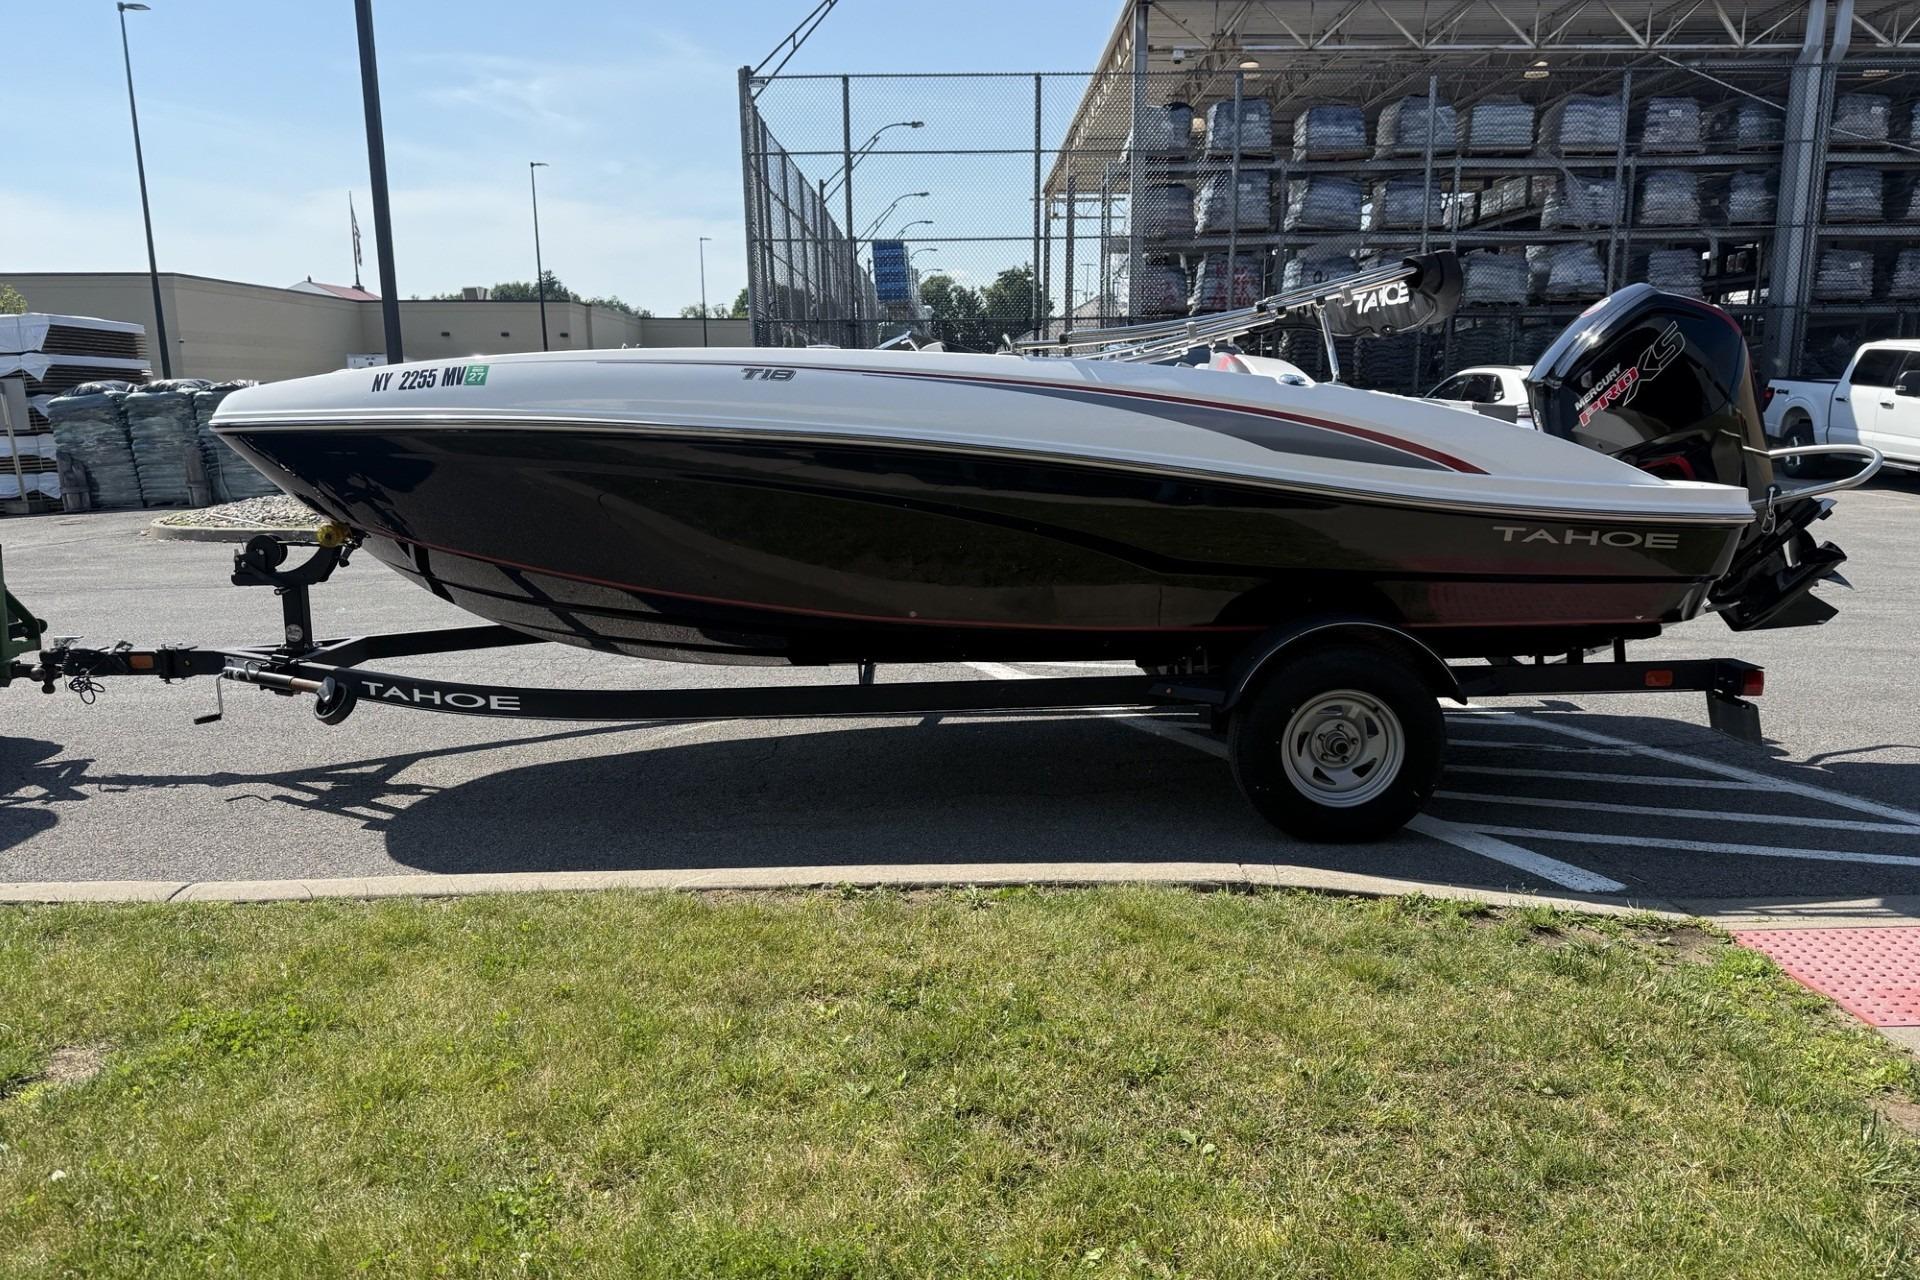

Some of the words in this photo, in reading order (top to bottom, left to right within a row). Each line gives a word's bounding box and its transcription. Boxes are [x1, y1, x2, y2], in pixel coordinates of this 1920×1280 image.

[371, 372, 394, 393] NY
[398, 368, 438, 391] 2255
[441, 366, 467, 387] MV
[467, 372, 486, 382] 27
[1574, 362, 1622, 411] MERCURY
[1578, 366, 1640, 428] PRO
[1622, 320, 1686, 407] XS
[1492, 526, 1680, 549] TAHOE
[361, 680, 521, 711] TAHOE
